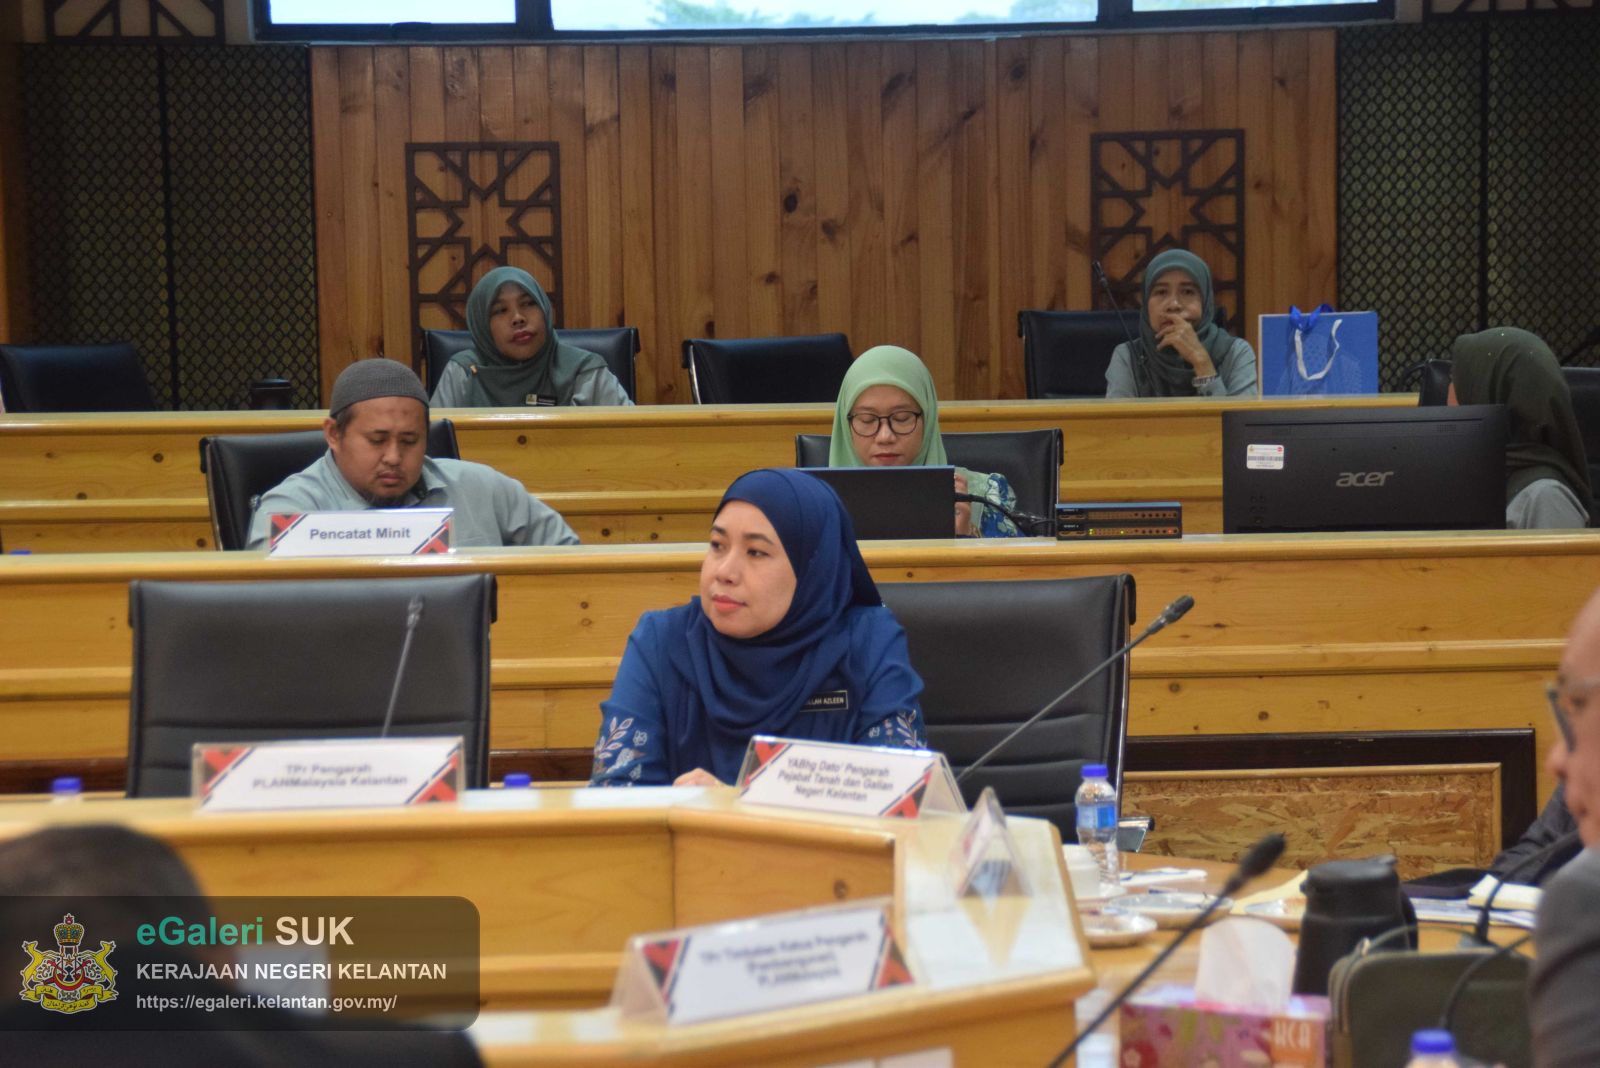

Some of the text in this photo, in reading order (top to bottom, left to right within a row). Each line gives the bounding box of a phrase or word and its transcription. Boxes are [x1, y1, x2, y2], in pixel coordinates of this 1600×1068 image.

[1336, 471, 1394, 487] acer
[310, 527, 411, 540] Pencatat Minit
[311, 763, 372, 777] Pengarah
[788, 758, 816, 772] YABhg
[845, 762, 890, 777] Pengarah
[252, 775, 408, 790] PLANMalaysia Kelantan
[814, 773, 840, 785] Tanah
[843, 775, 861, 786] dan
[863, 777, 894, 790] Galian
[794, 785, 868, 801] Negeri Kelantan
